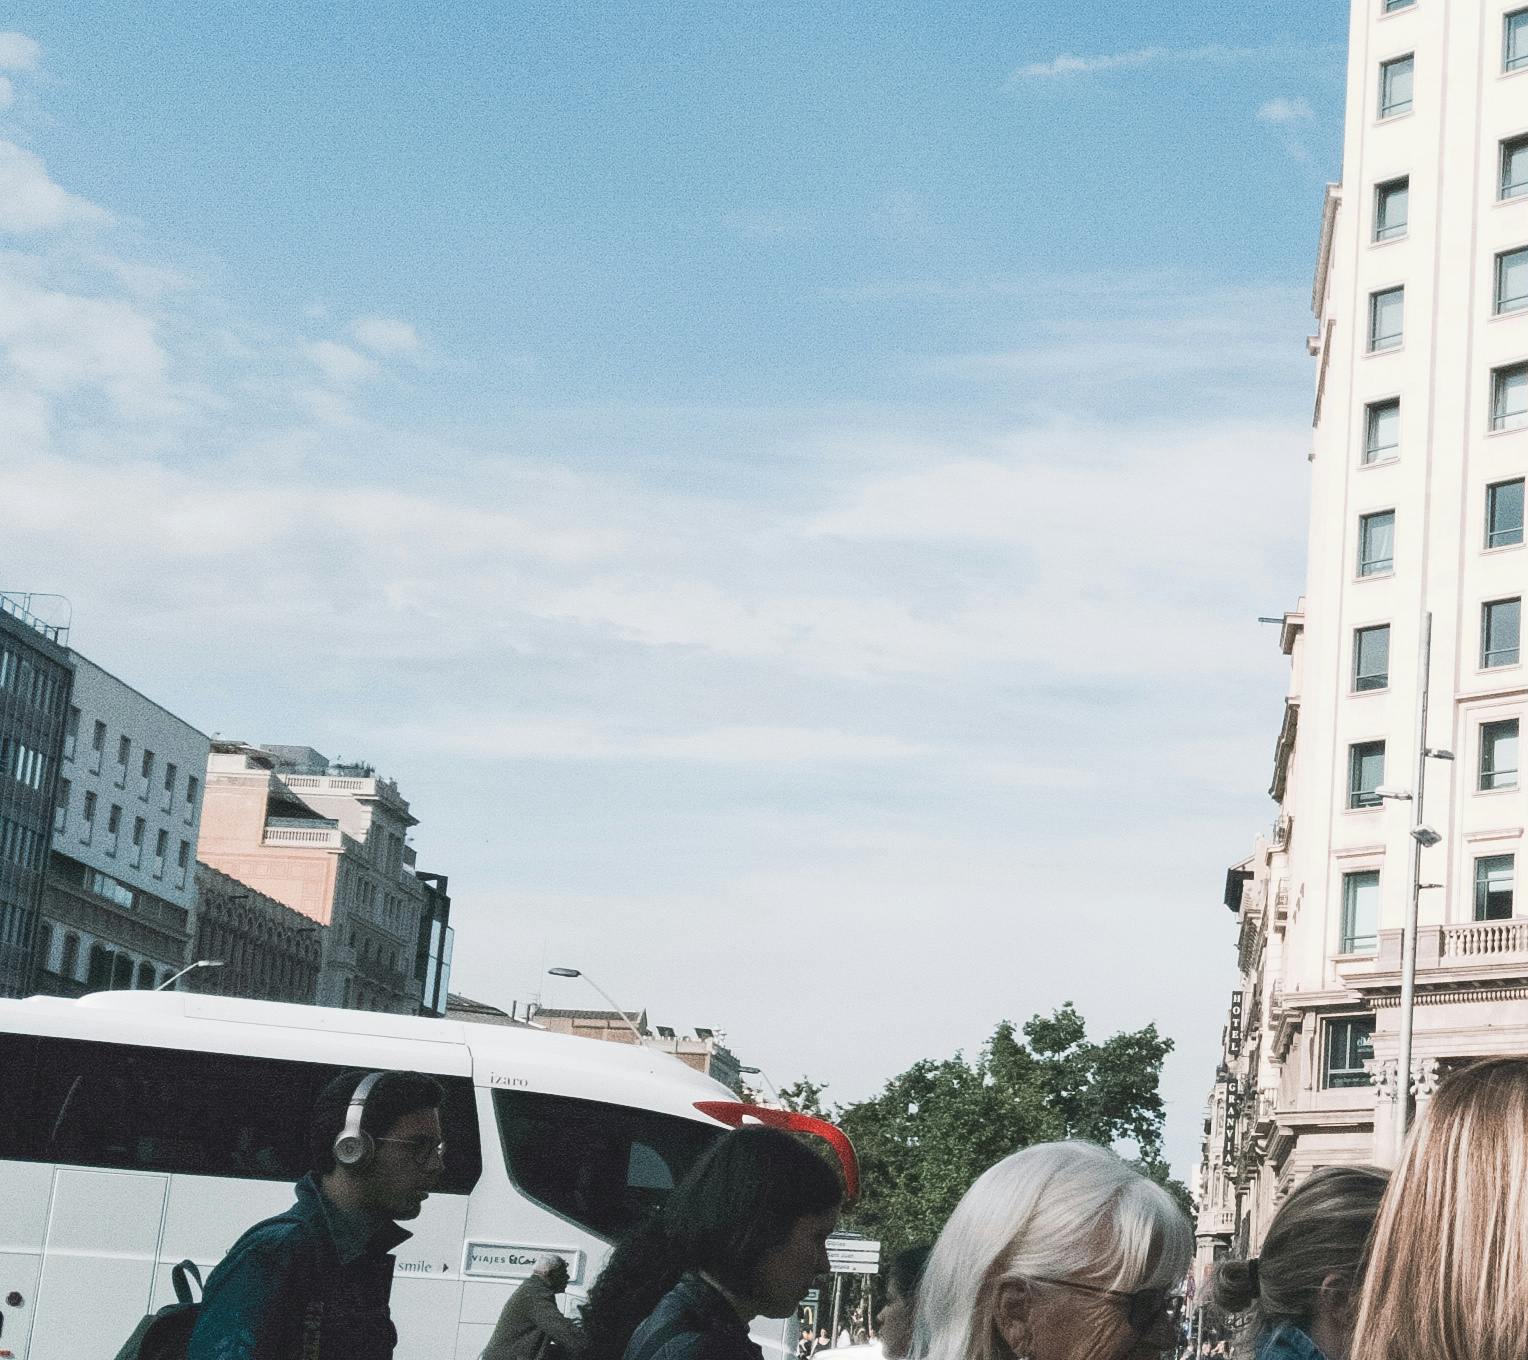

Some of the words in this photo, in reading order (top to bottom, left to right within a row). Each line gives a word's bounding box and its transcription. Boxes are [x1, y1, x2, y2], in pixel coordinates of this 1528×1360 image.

[1231, 994, 1241, 1052] HOTEL
[472, 1255, 506, 1264] VIAJES
[398, 1260, 431, 1272] smile
